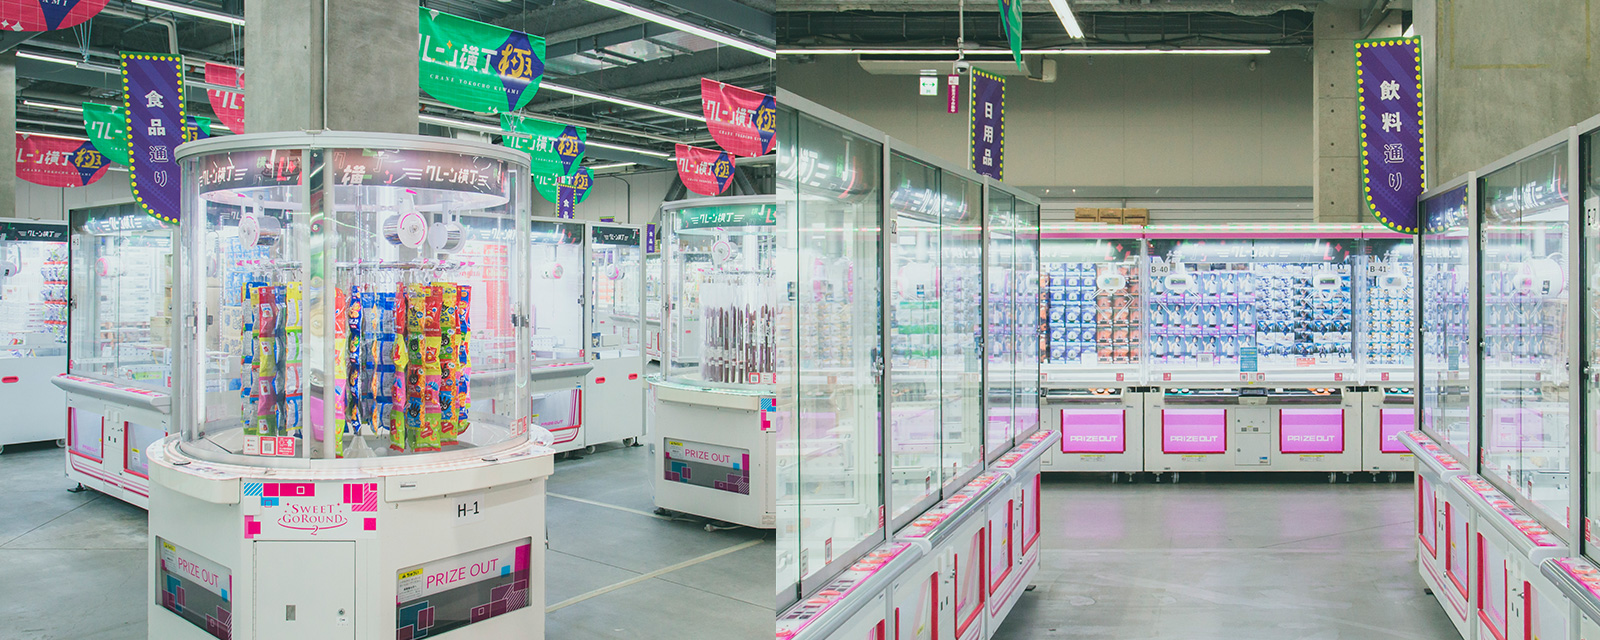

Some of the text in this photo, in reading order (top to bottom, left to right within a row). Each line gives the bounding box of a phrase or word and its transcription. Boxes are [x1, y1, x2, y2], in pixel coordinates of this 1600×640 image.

[419, 33, 498, 74] レーン横丁
[144, 90, 169, 188] 食品通り
[982, 101, 994, 177] 日用品
[1380, 80, 1405, 191] 飲料通り
[16, 147, 74, 167] レーン横丁
[684, 448, 709, 461] PRIZE
[711, 453, 730, 464] OUT
[457, 501, 480, 518] H-1
[178, 557, 200, 580] PRIZE
[201, 569, 220, 588] OUT
[426, 566, 467, 589] PRIZE
[469, 558, 499, 577] OUT
